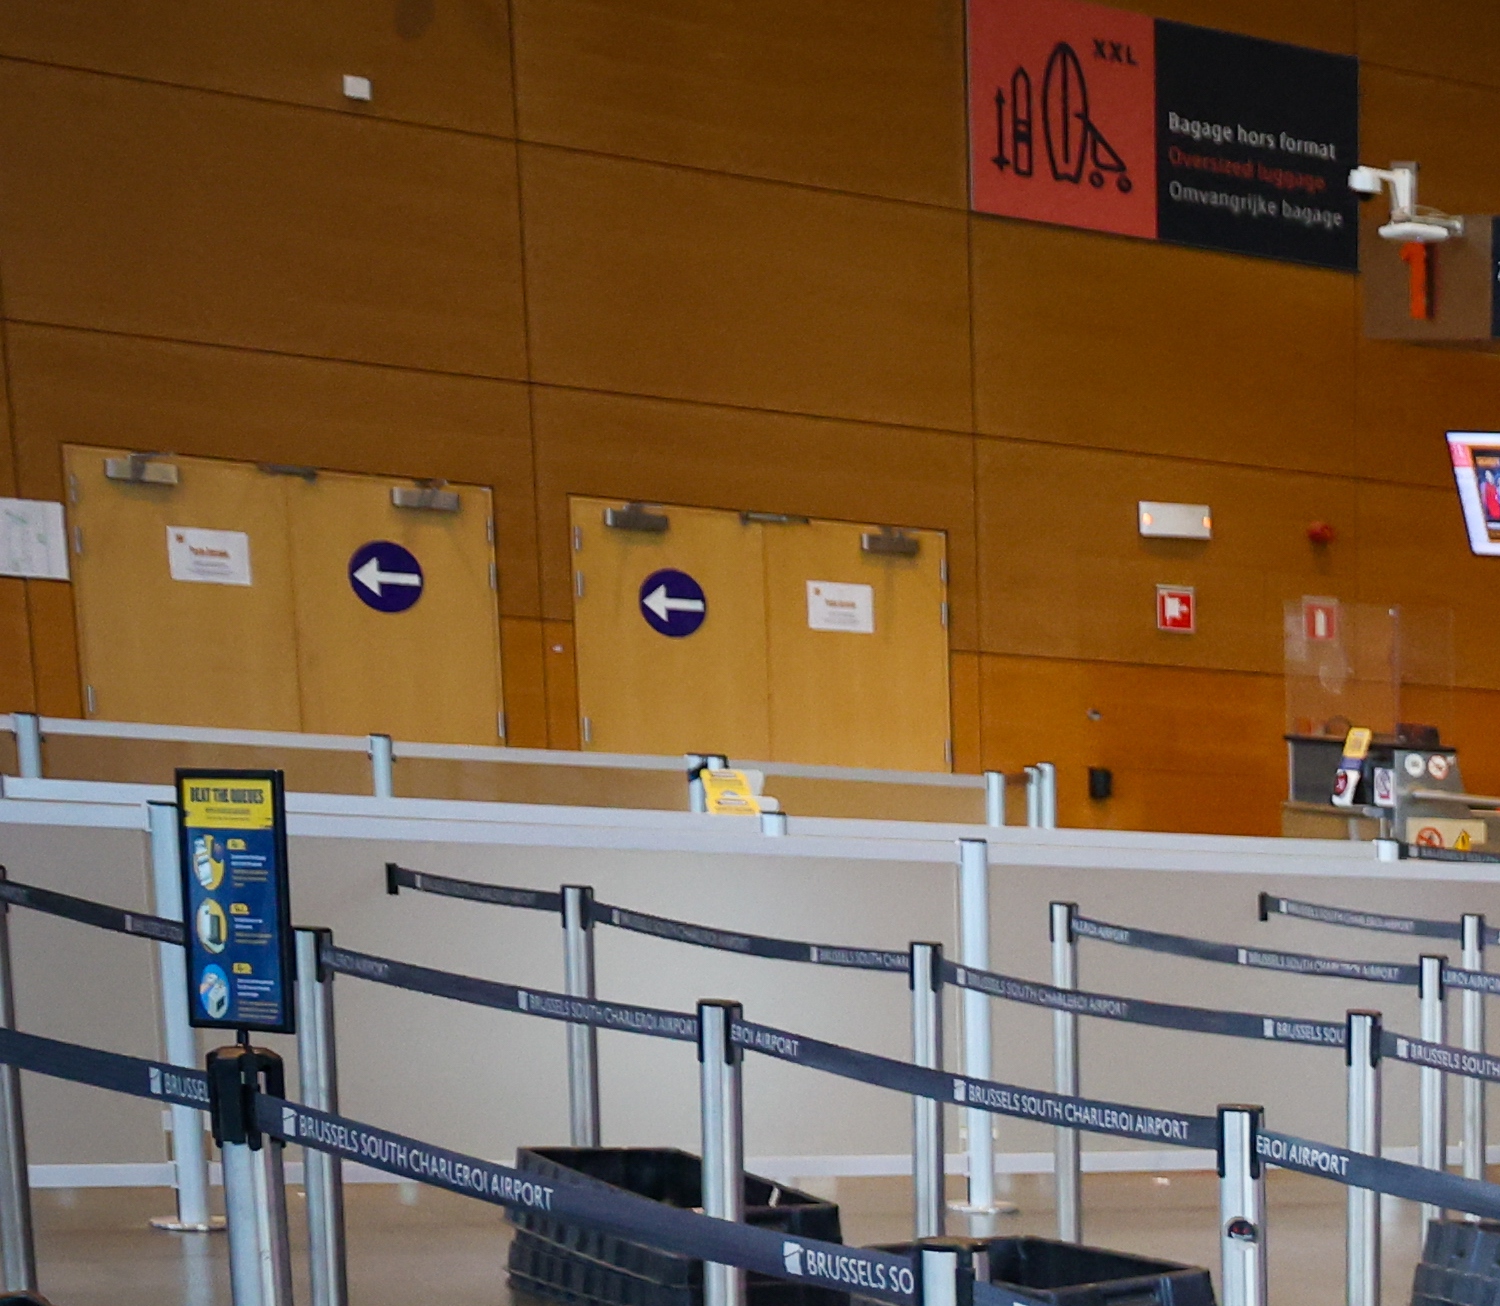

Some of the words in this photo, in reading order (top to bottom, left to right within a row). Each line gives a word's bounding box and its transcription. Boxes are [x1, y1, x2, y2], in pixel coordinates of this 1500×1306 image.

[1093, 39, 1137, 66] XXL
[1168, 111, 1233, 143] Bagage
[1238, 123, 1274, 149] hors
[1280, 131, 1337, 160] format
[1168, 146, 1253, 178] Oversized
[1257, 162, 1327, 194] luggage
[1169, 181, 1277, 217] Omvangrijke
[1282, 200, 1343, 229] bagage
[1401, 243, 1433, 319] 1
[969, 1082, 1019, 1113] BRUSSELS
[1021, 1093, 1063, 1121] SOUTH
[1064, 1102, 1133, 1133] CHARLEROI
[1135, 1113, 1189, 1142] AIRPORT
[300, 1114, 358, 1154] BRUSSELS
[360, 1130, 408, 1168] SOUTH
[410, 1147, 488, 1194] CHARLEROI
[491, 1173, 554, 1211] AIRPORT
[1289, 1145, 1349, 1176] AIRPORT
[807, 1249, 886, 1291] BRUSSELS
